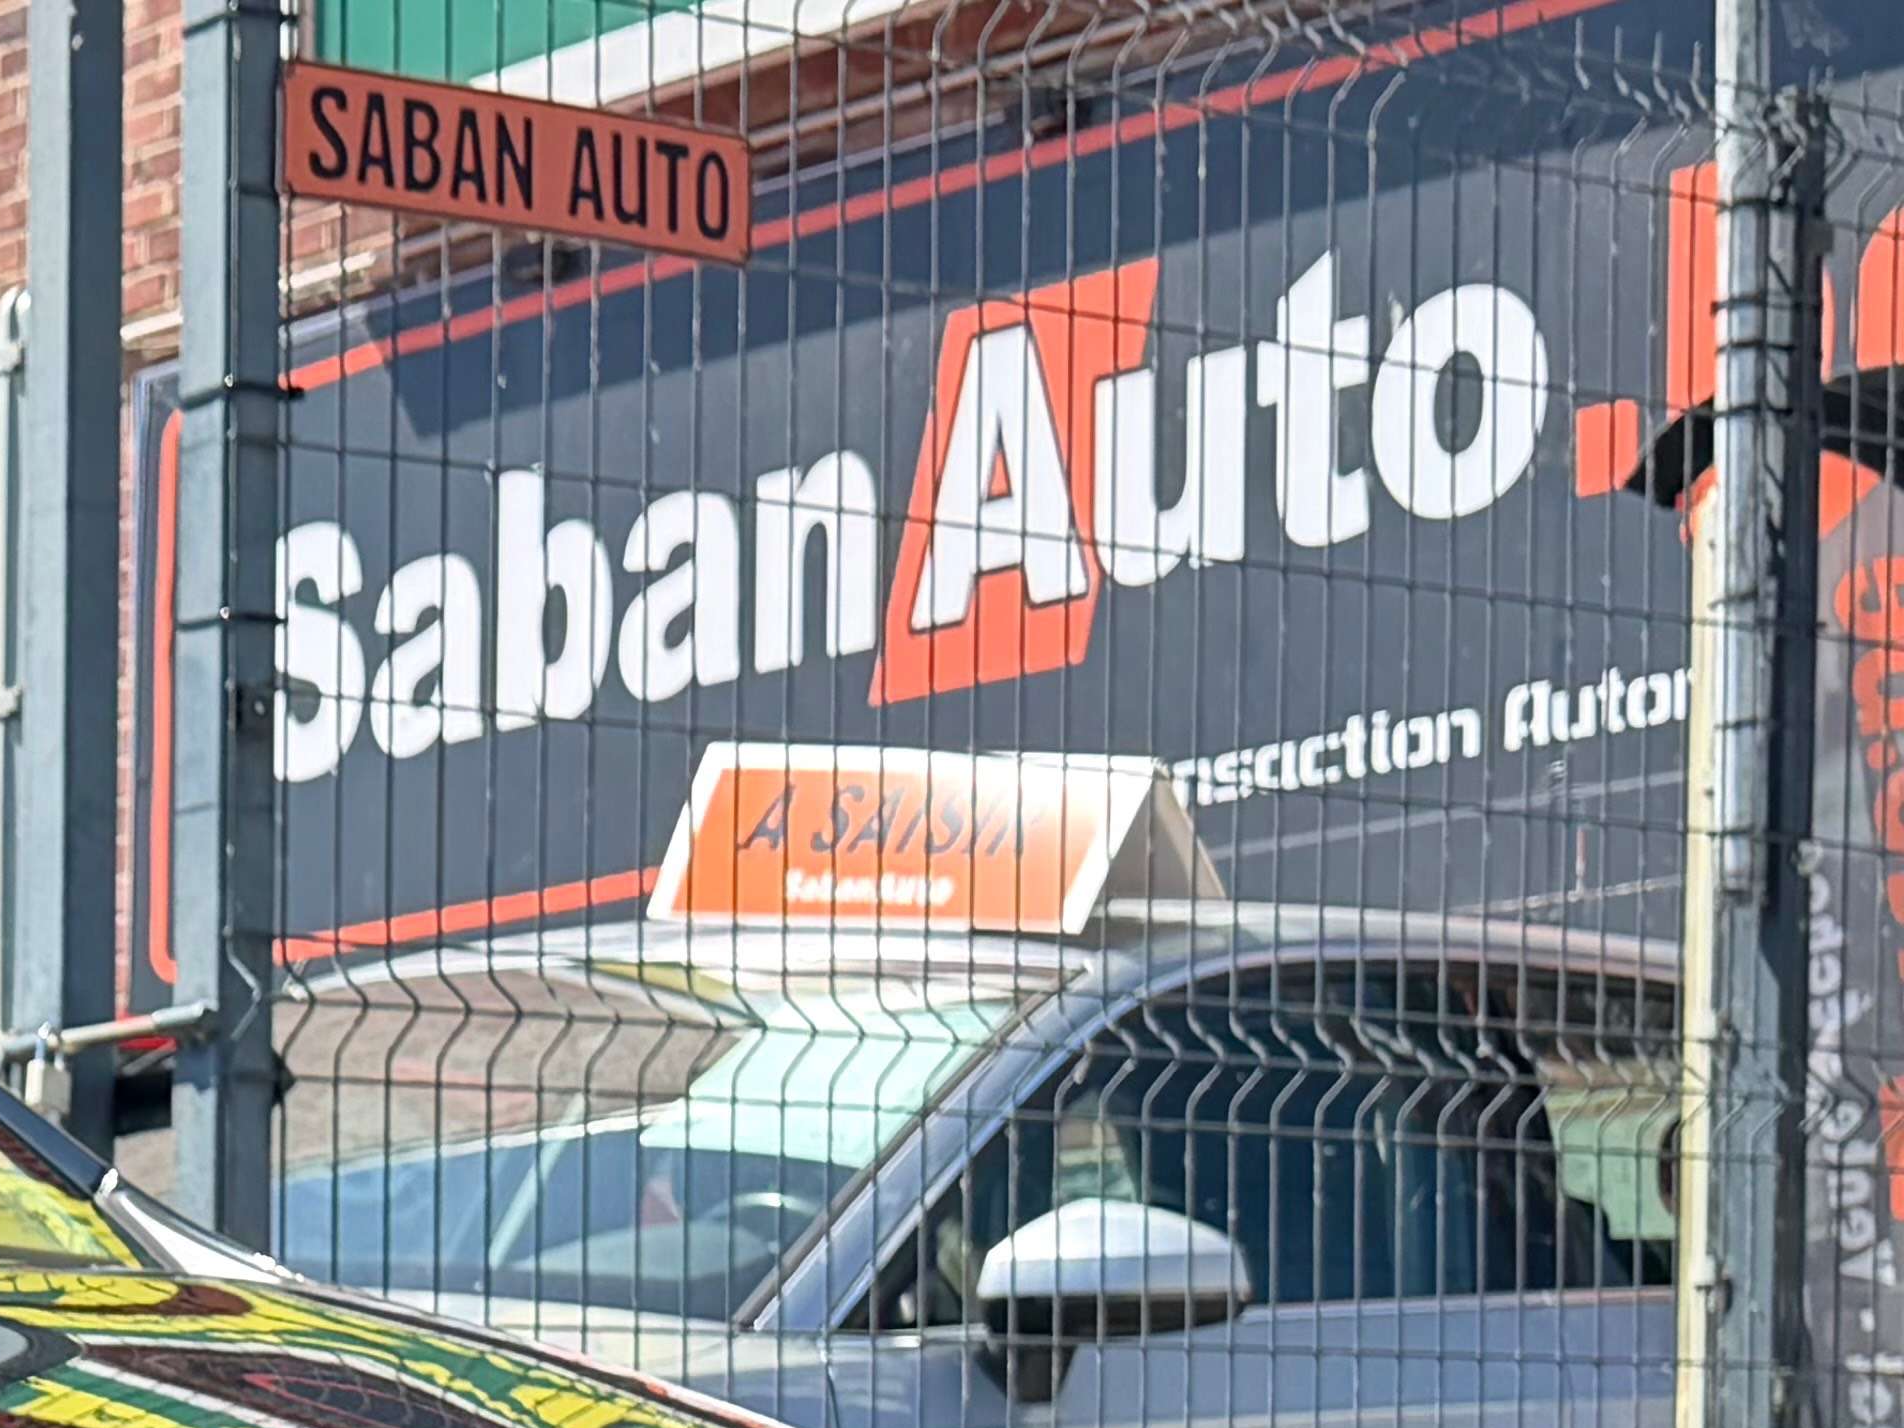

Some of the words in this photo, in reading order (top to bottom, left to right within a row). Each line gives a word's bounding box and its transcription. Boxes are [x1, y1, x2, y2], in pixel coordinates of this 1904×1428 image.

[307, 86, 534, 209] SABAN
[567, 126, 730, 240] AUTO
[275, 160, 1904, 783] SabanAuto.
[1172, 706, 1482, 808] nsaction
